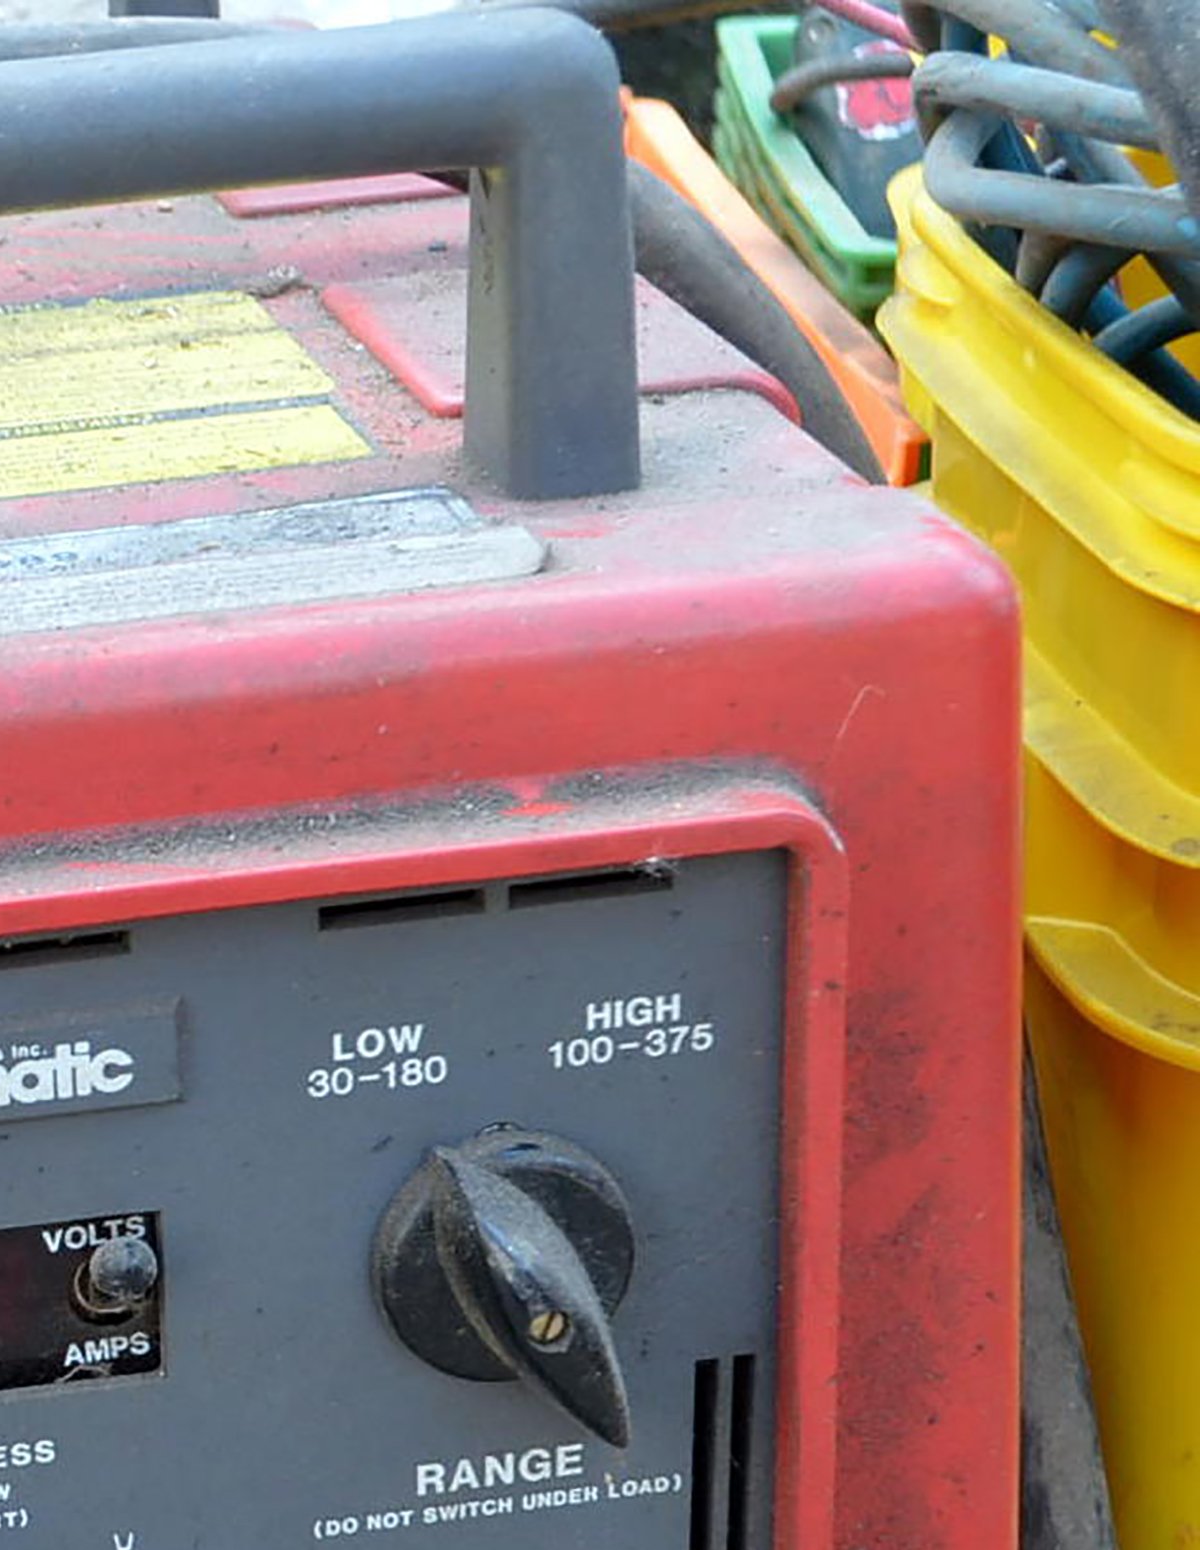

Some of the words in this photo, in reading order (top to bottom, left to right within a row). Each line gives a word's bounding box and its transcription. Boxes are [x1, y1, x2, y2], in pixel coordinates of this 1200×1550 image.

[586, 993, 682, 1031] HIGH
[11, 1044, 49, 1059] Inc.
[332, 1023, 425, 1061] LOW
[548, 1023, 714, 1069] 100-375
[41, 1215, 147, 1254] VOLTS
[63, 1332, 151, 1367] AMPS
[416, 1443, 585, 1496] RANGE
[313, 1516, 359, 1540] (DO
[366, 1509, 413, 1531] NOT
[422, 1496, 513, 1524] SWITCH
[607, 1473, 682, 1499] LOAD)
